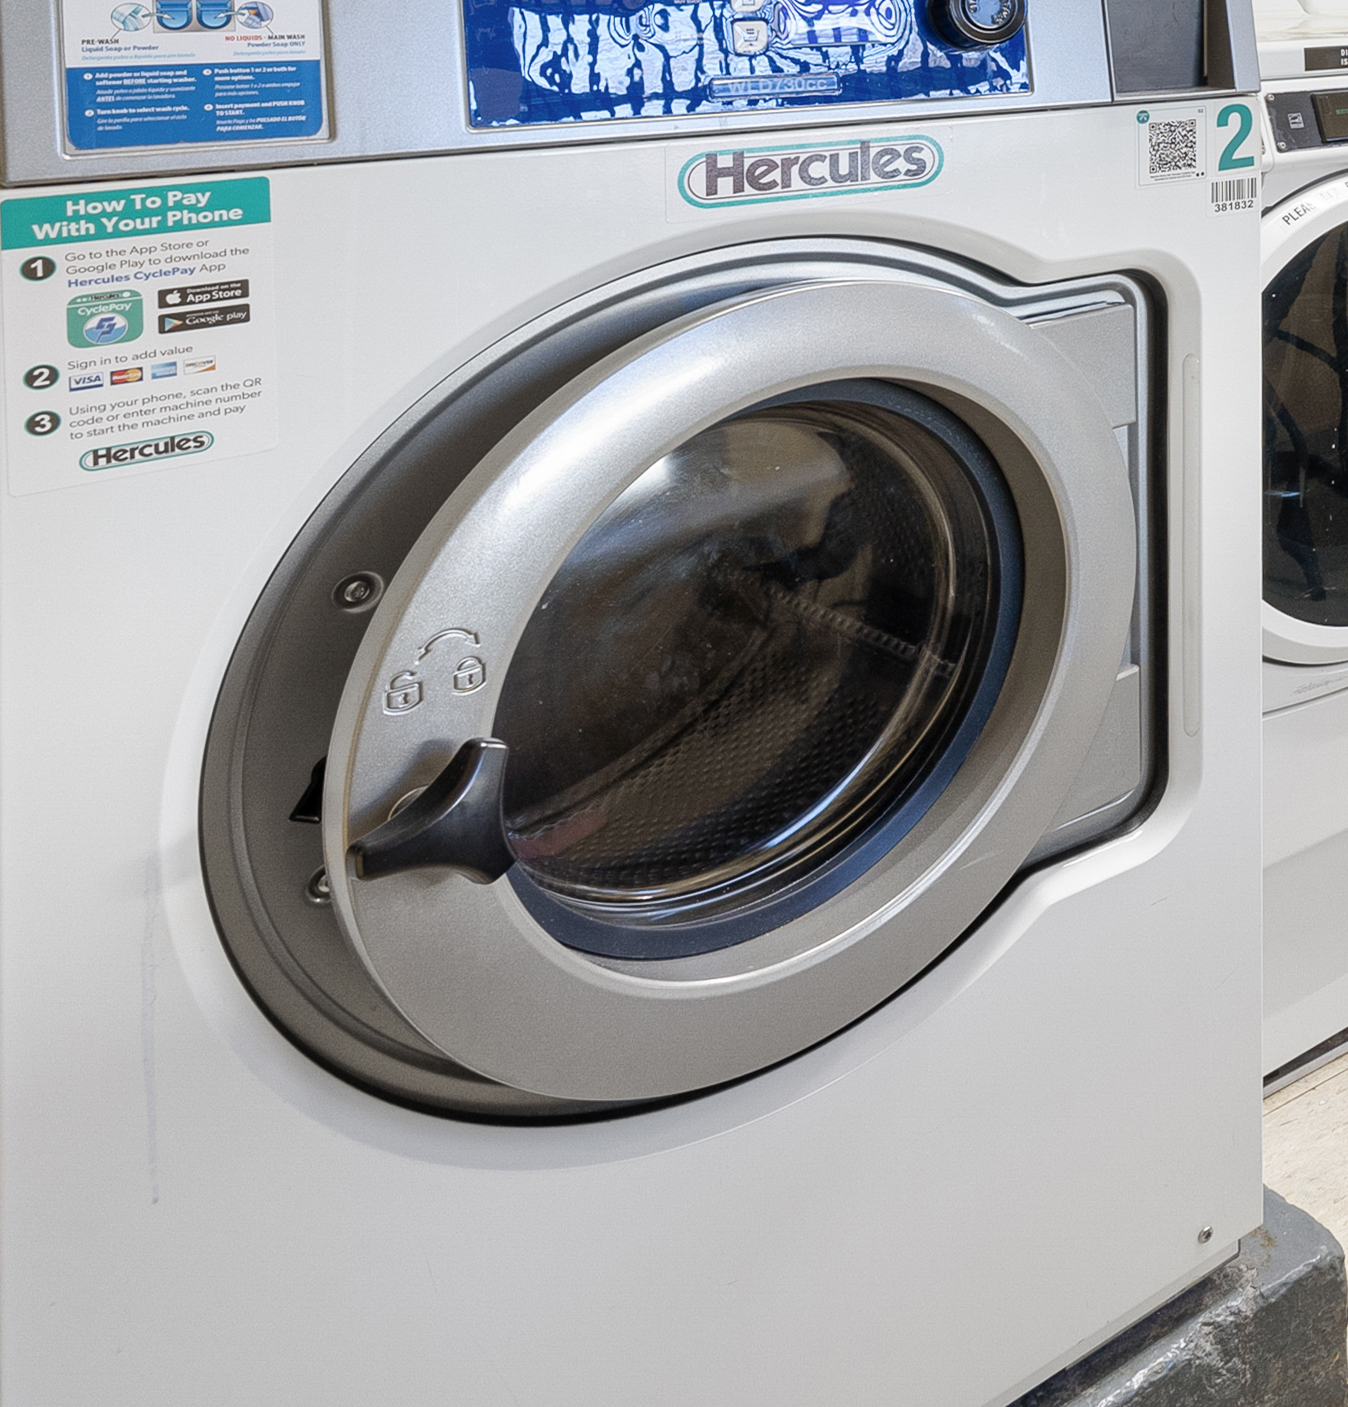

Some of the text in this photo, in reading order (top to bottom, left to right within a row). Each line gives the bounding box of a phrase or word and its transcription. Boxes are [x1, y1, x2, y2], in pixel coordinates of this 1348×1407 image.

[1340, 57, 1348, 66] IS
[729, 78, 827, 94] WLD730cc
[1217, 103, 1254, 172] 2
[705, 140, 927, 197] Hercules
[65, 191, 212, 217] How To Pay
[1214, 199, 1254, 213] 381832
[31, 207, 243, 240] With Your Phone
[64, 240, 210, 262] Go to the App Store or
[65, 246, 250, 276] Google Play to download the
[30, 260, 44, 277] 1
[67, 262, 227, 288] Hercules CyclePay App
[186, 287, 242, 305] App Store
[77, 302, 132, 317] CyclePay
[185, 309, 248, 326] Google play
[67, 345, 194, 371] Sign in to add value
[31, 367, 51, 387] 2
[33, 413, 52, 433] 3
[91, 433, 206, 467] Hercules
